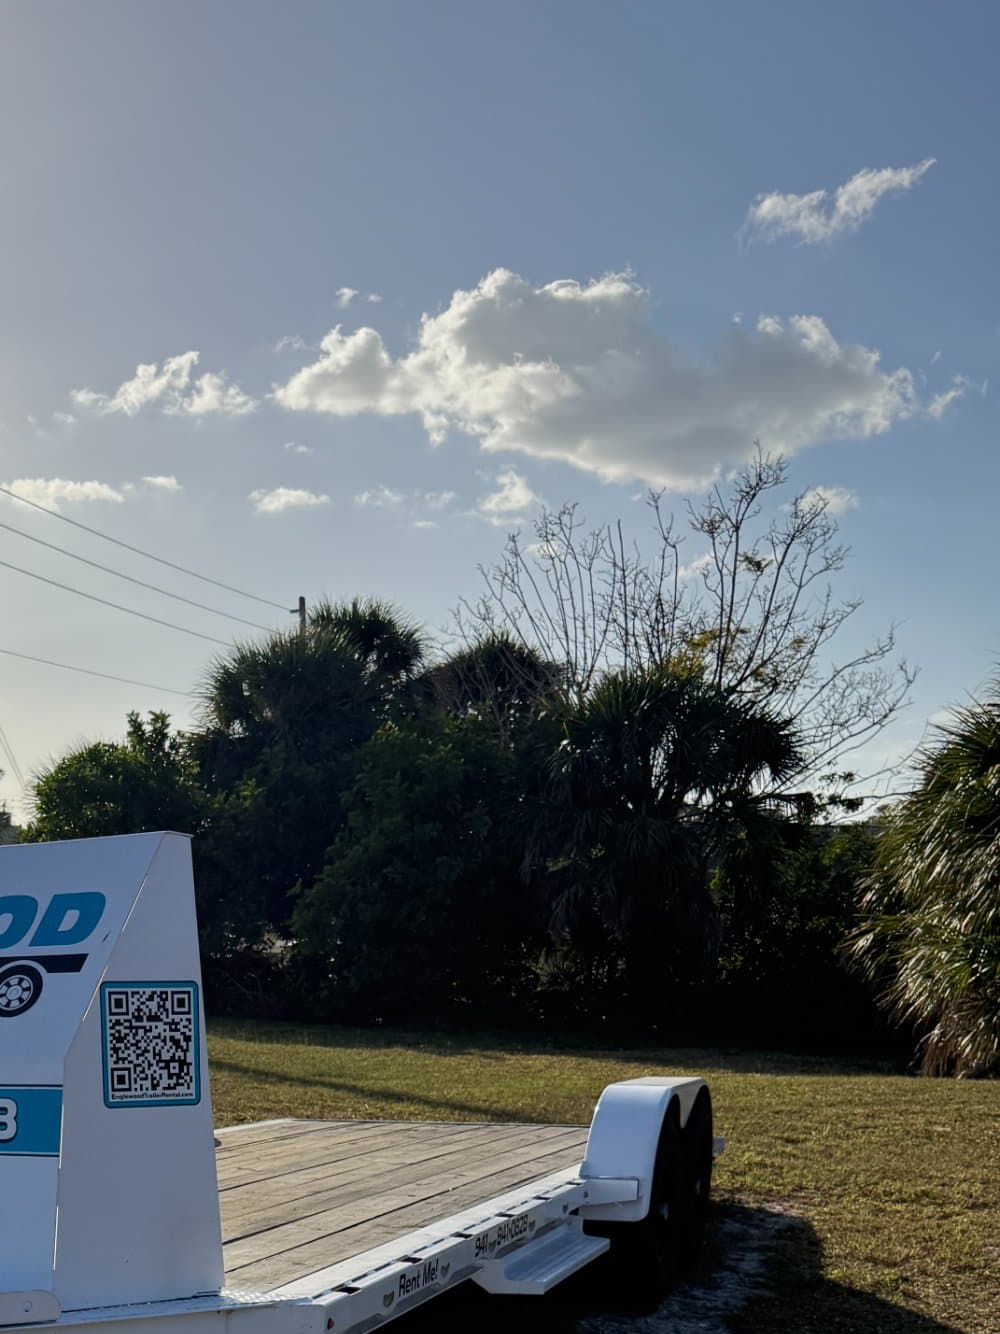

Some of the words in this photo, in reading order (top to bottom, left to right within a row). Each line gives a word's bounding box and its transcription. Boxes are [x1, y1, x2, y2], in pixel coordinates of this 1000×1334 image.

[474, 1233, 489, 1257] 941
[398, 1273, 421, 1298] Rent
[422, 1259, 439, 1286] Me!
